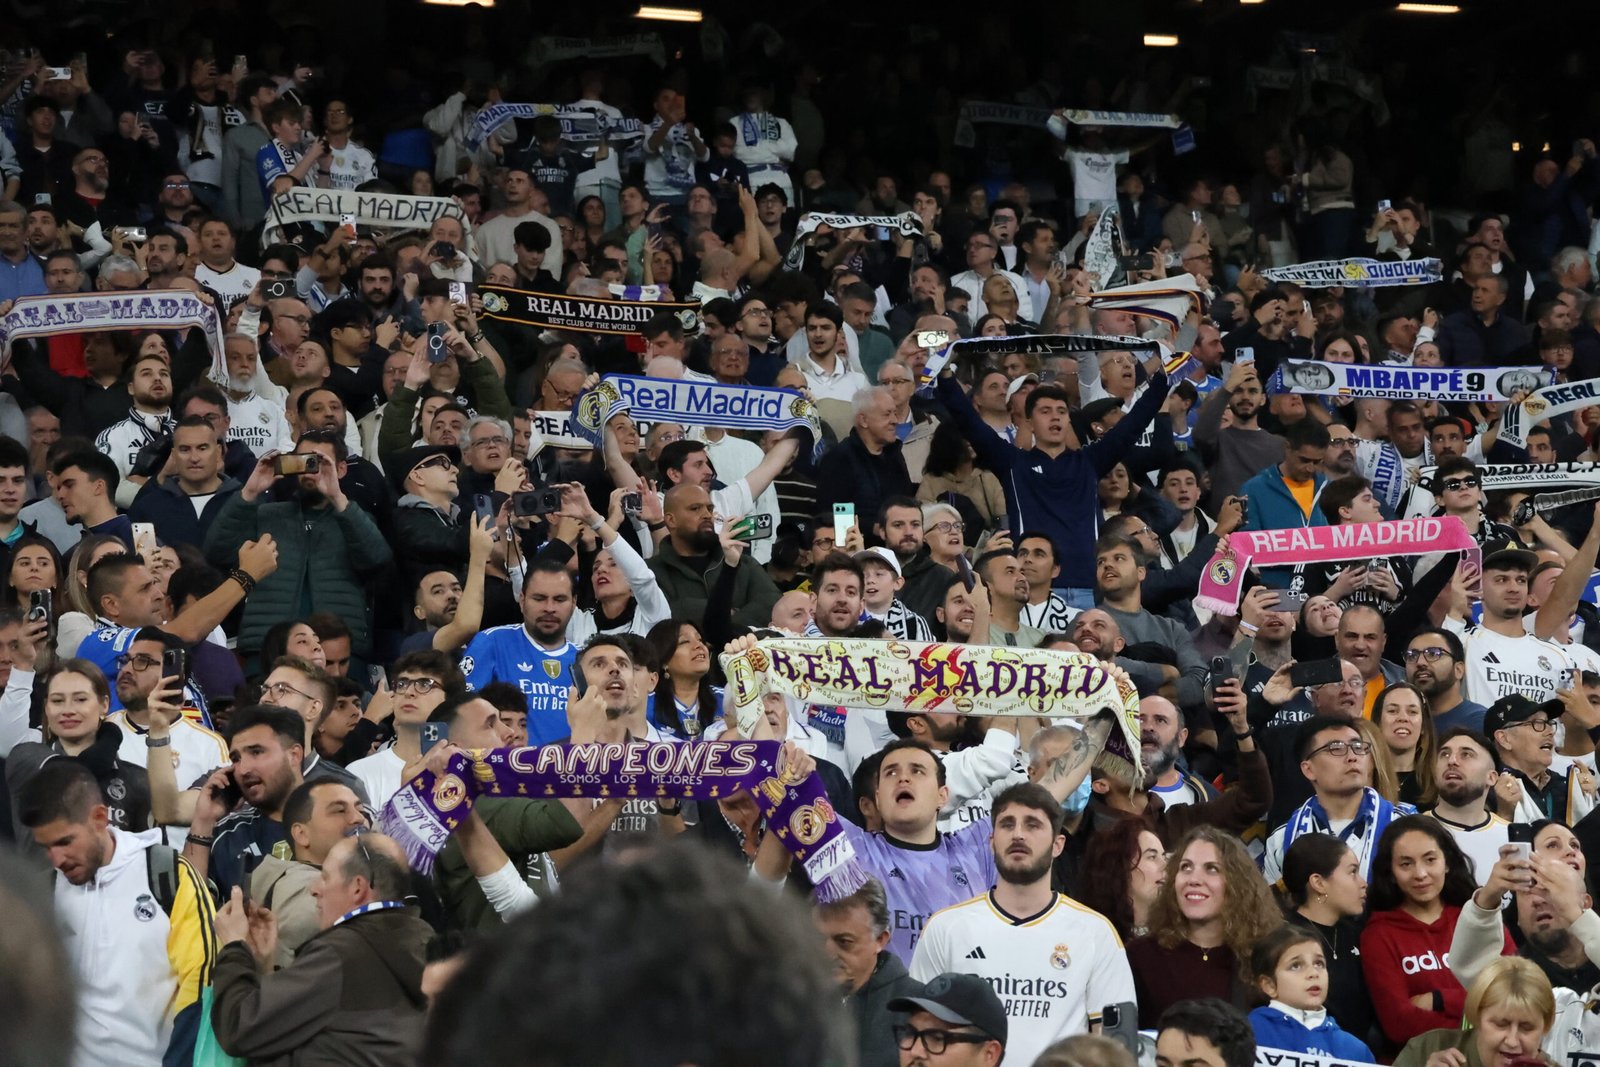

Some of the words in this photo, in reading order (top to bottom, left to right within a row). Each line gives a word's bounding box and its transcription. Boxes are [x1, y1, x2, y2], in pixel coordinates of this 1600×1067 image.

[276, 192, 354, 217] REAL
[358, 196, 466, 222] MADRID
[1368, 260, 1425, 278] MADRID
[4, 302, 84, 331] REAL
[526, 296, 576, 317] REAL
[579, 302, 654, 322] MADRID
[548, 317, 566, 325] BEST
[566, 318, 584, 328] CLUB
[585, 320, 594, 328] OF
[595, 321, 609, 329] THE
[610, 322, 636, 331] WORLD
[1346, 368, 1463, 392] MBAPPÉ
[1466, 372, 1485, 392] 9
[618, 379, 676, 411] Real
[687, 386, 784, 418] Madrid
[1351, 389, 1419, 400] MADRID
[1421, 392, 1479, 401] PLAYER
[1541, 382, 1600, 406] REAL
[227, 426, 272, 438] mirates
[534, 417, 578, 437] REA
[1483, 474, 1534, 483] CHAMPIONS
[1535, 473, 1569, 481] LEAGUE
[1251, 528, 1324, 553] REAL
[1331, 519, 1441, 548] MADRID
[771, 649, 892, 694] REAL
[908, 658, 1109, 698] MADRID
[1486, 667, 1554, 691] Emirates
[532, 697, 549, 710] FLY
[815, 710, 845, 726] Madr
[456, 758, 469, 772] 94
[491, 754, 504, 763] 95
[509, 742, 758, 777] CAMPEONES
[760, 760, 773, 772] 94
[560, 774, 600, 784] SOMOS
[614, 774, 637, 784] LOS
[651, 774, 703, 785] MEJORES
[788, 788, 799, 800] 95
[985, 973, 1068, 998] mirates
